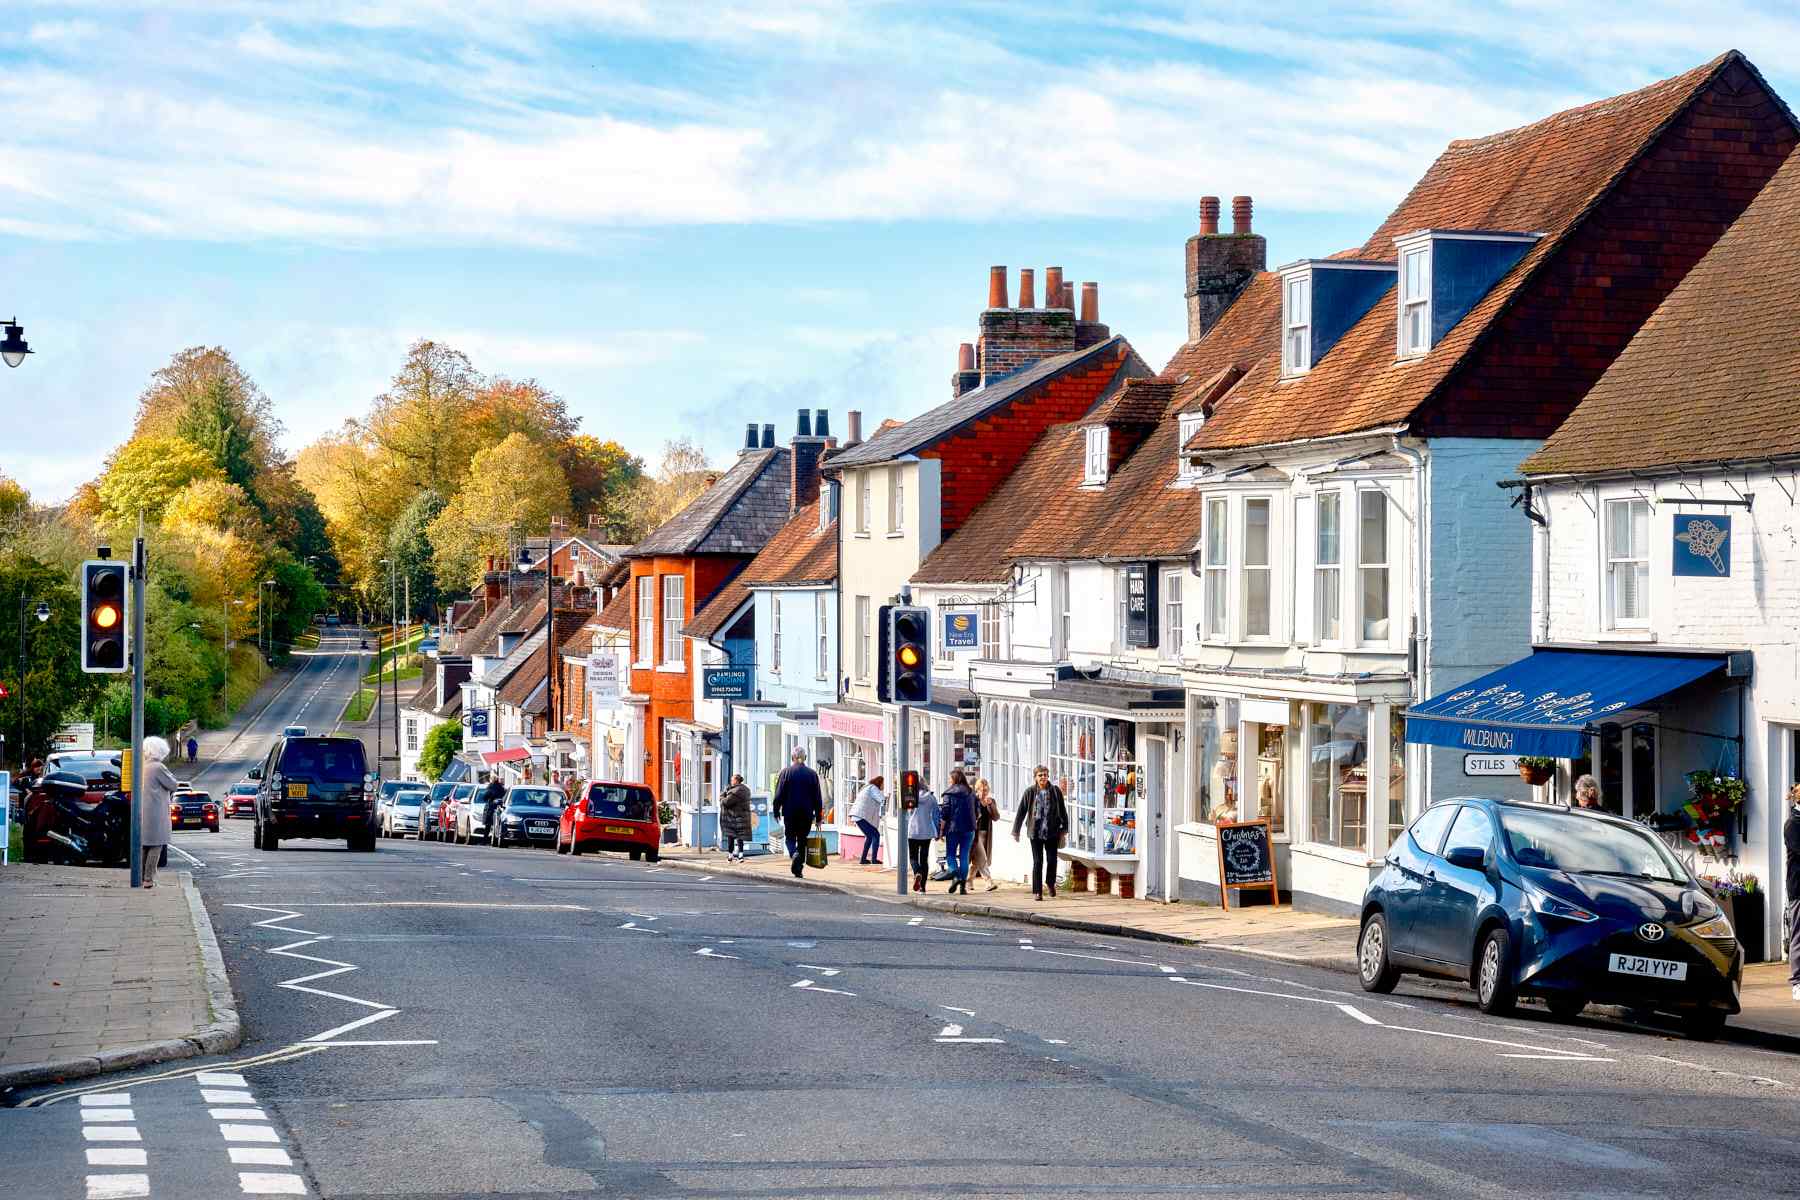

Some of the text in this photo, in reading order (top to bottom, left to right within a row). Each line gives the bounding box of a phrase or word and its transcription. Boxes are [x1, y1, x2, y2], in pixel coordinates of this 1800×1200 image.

[1129, 579, 1144, 594] HAIR
[1130, 597, 1145, 612] CARE
[1463, 729, 1514, 750] WILDBUNCH
[1471, 759, 1505, 770] STILES
[1222, 829, 1259, 841] Christmas
[1618, 956, 1678, 976] RJ21 YYP
